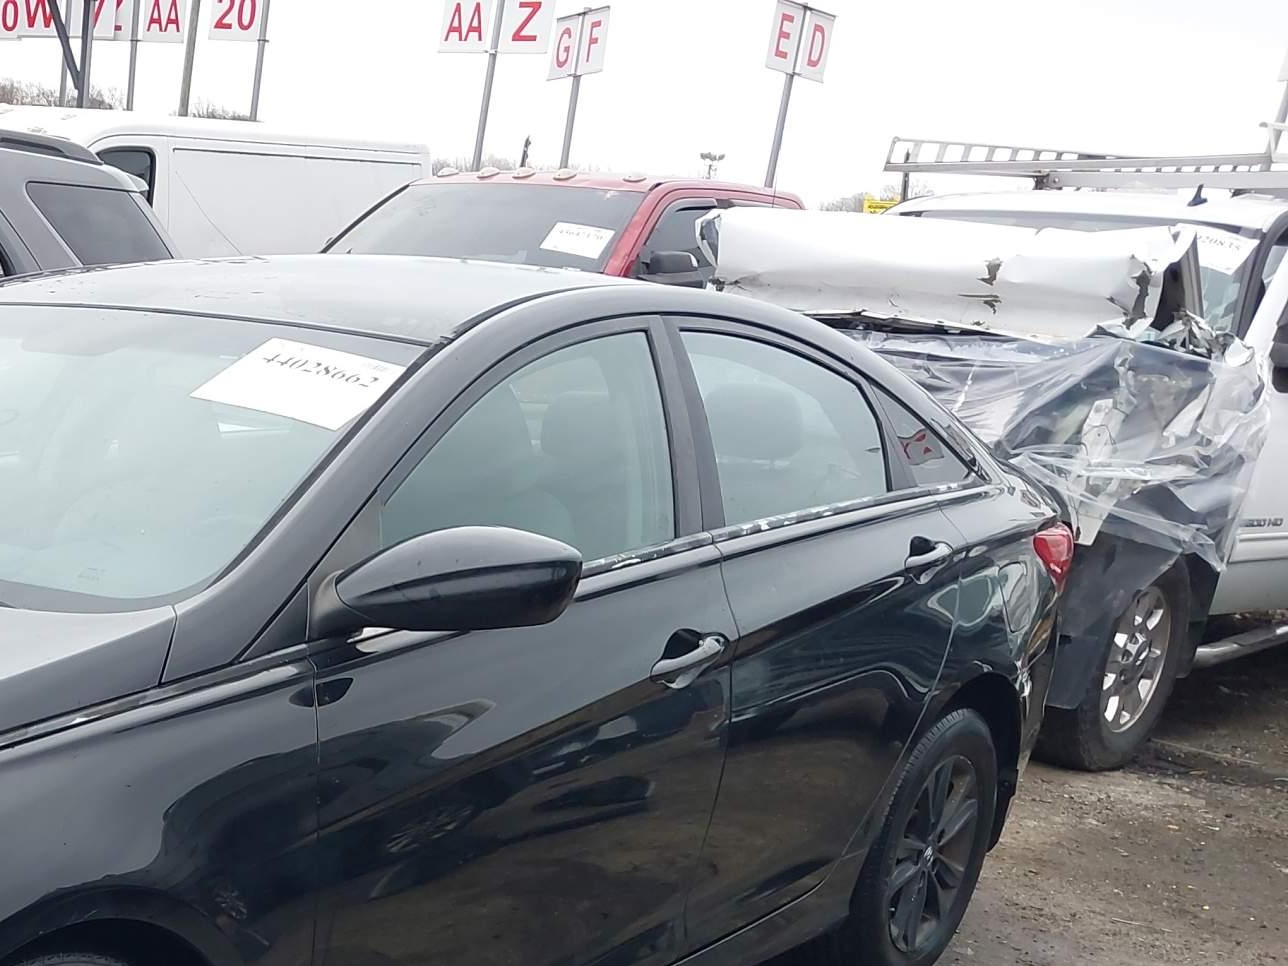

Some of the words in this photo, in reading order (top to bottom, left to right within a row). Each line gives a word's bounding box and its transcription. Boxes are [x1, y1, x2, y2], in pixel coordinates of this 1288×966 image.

[146, 0, 180, 32] AA
[213, 0, 257, 31] 20
[444, 2, 484, 42] AA
[511, 1, 543, 42] Z
[775, 12, 795, 60] E
[556, 27, 572, 69] G
[586, 20, 601, 63] F
[807, 26, 826, 68] D
